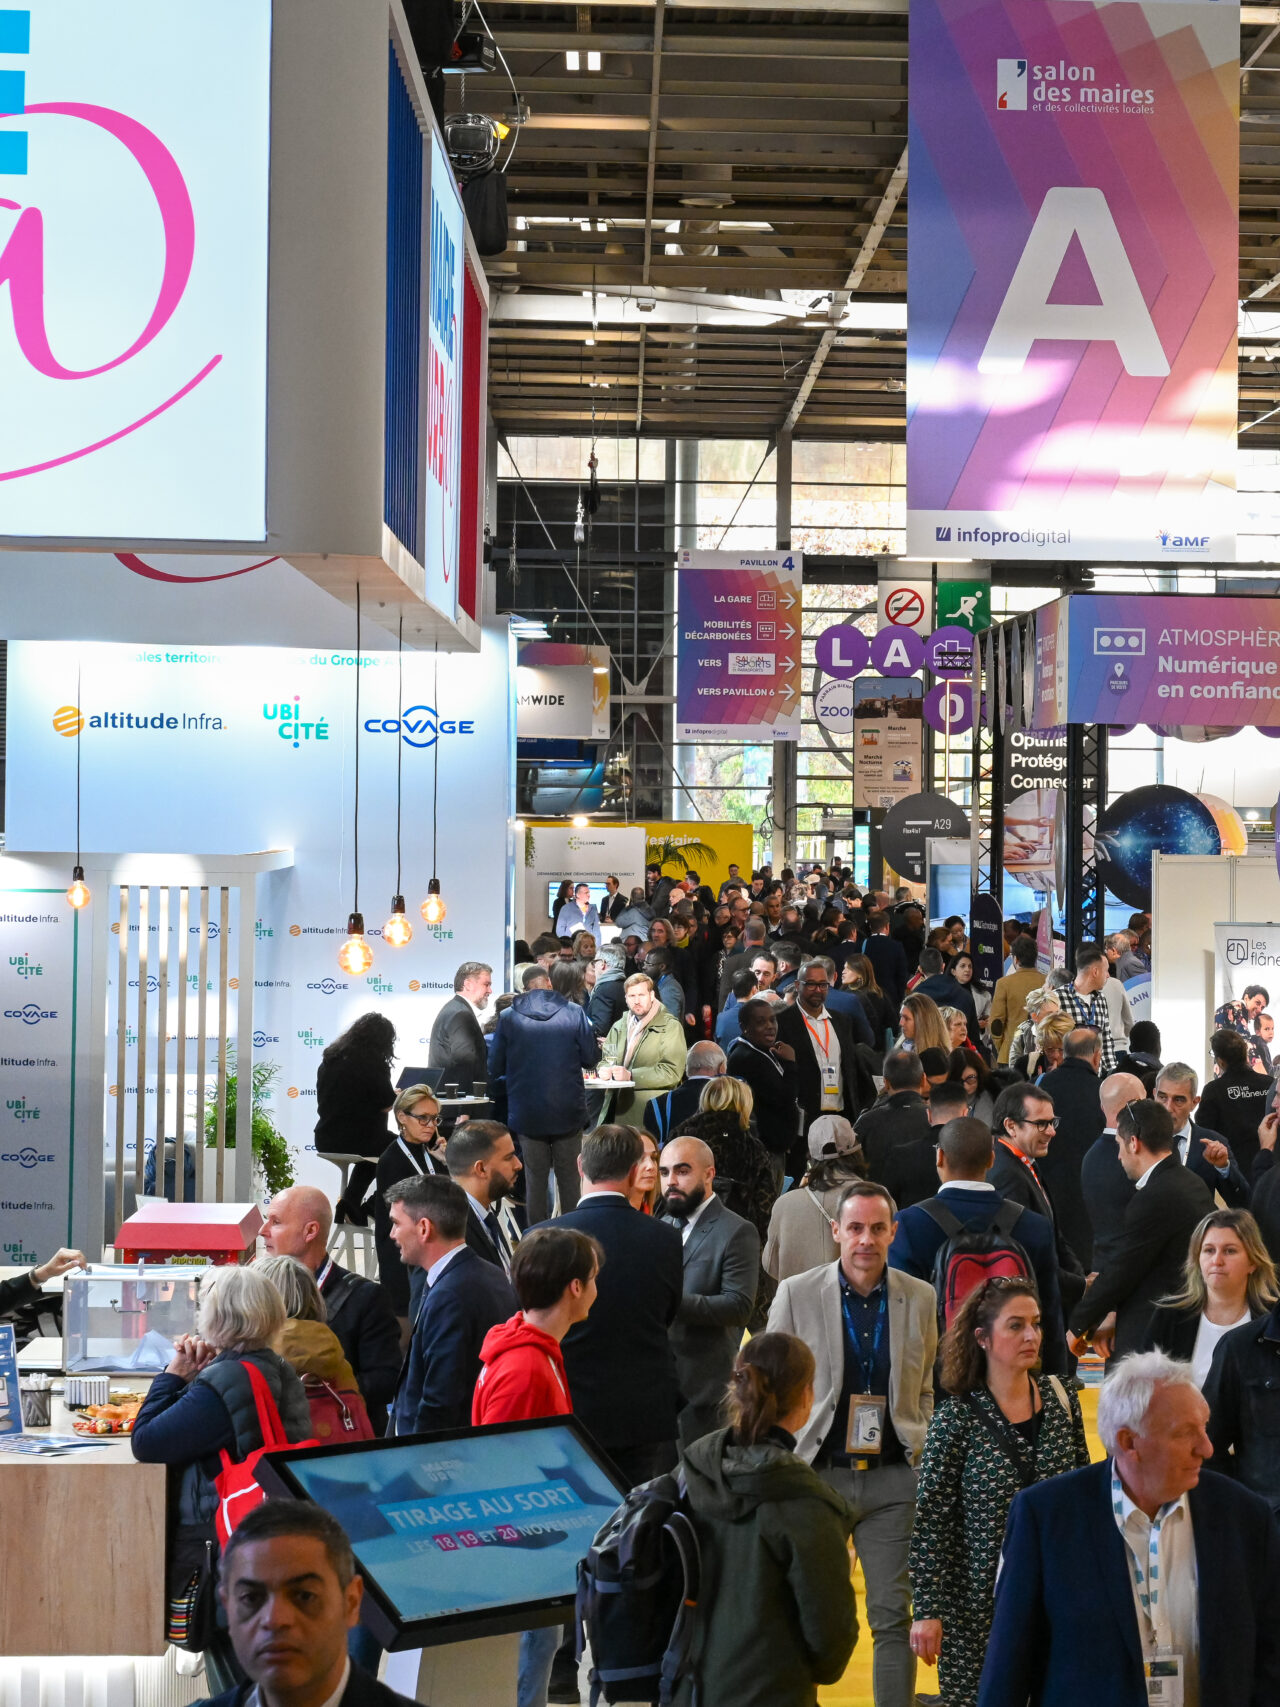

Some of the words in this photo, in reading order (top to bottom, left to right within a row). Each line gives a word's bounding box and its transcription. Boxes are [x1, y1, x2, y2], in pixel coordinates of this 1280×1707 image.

[1032, 60, 1095, 81] salon
[1033, 81, 1071, 102] des
[1079, 83, 1154, 104] maires
[1032, 104, 1042, 112] et
[1045, 104, 1062, 112] des
[1064, 105, 1120, 114] collectivités
[1122, 105, 1154, 114] locales
[977, 186, 1171, 376] A
[956, 526, 1071, 546] infoprodigital
[740, 559, 778, 567] PAVILLON
[781, 556, 795, 571] 4
[713, 595, 725, 603] LA
[727, 595, 752, 603] GARE
[703, 620, 752, 629] MOBILITÉS
[684, 630, 752, 640] DÉCARBONÉES
[165, 652, 223, 664] territoir
[310, 654, 328, 666] du
[330, 654, 380, 668] Groupe
[698, 659, 722, 667] VERS
[1158, 655, 1278, 679] Numérique
[697, 687, 721, 696] VERS
[722, 688, 767, 697] PAVILLON
[769, 688, 775, 696] 6
[1158, 684, 1184, 698] en
[263, 695, 300, 720] UBI
[89, 711, 179, 729] altitude
[182, 713, 228, 730] Infra.
[364, 719, 475, 734] COVAGE
[278, 716, 329, 740] CITÉ
[1011, 752, 1068, 772] Protége
[1011, 774, 1095, 790] Connecer
[934, 818, 952, 830] A29
[1251, 939, 1266, 950] Les
[4, 1010, 58, 1019] COVAGE
[0, 1057, 36, 1067] ltitude
[1, 1154, 55, 1162] COVAGE
[387, 1501, 478, 1529] TIRAGE
[479, 1495, 514, 1518] AU
[516, 1486, 576, 1512] SORT
[458, 1532, 479, 1546] 19
[480, 1529, 499, 1543] ET
[498, 1526, 517, 1541] 20
[516, 1514, 600, 1537] NOVEMBRE
